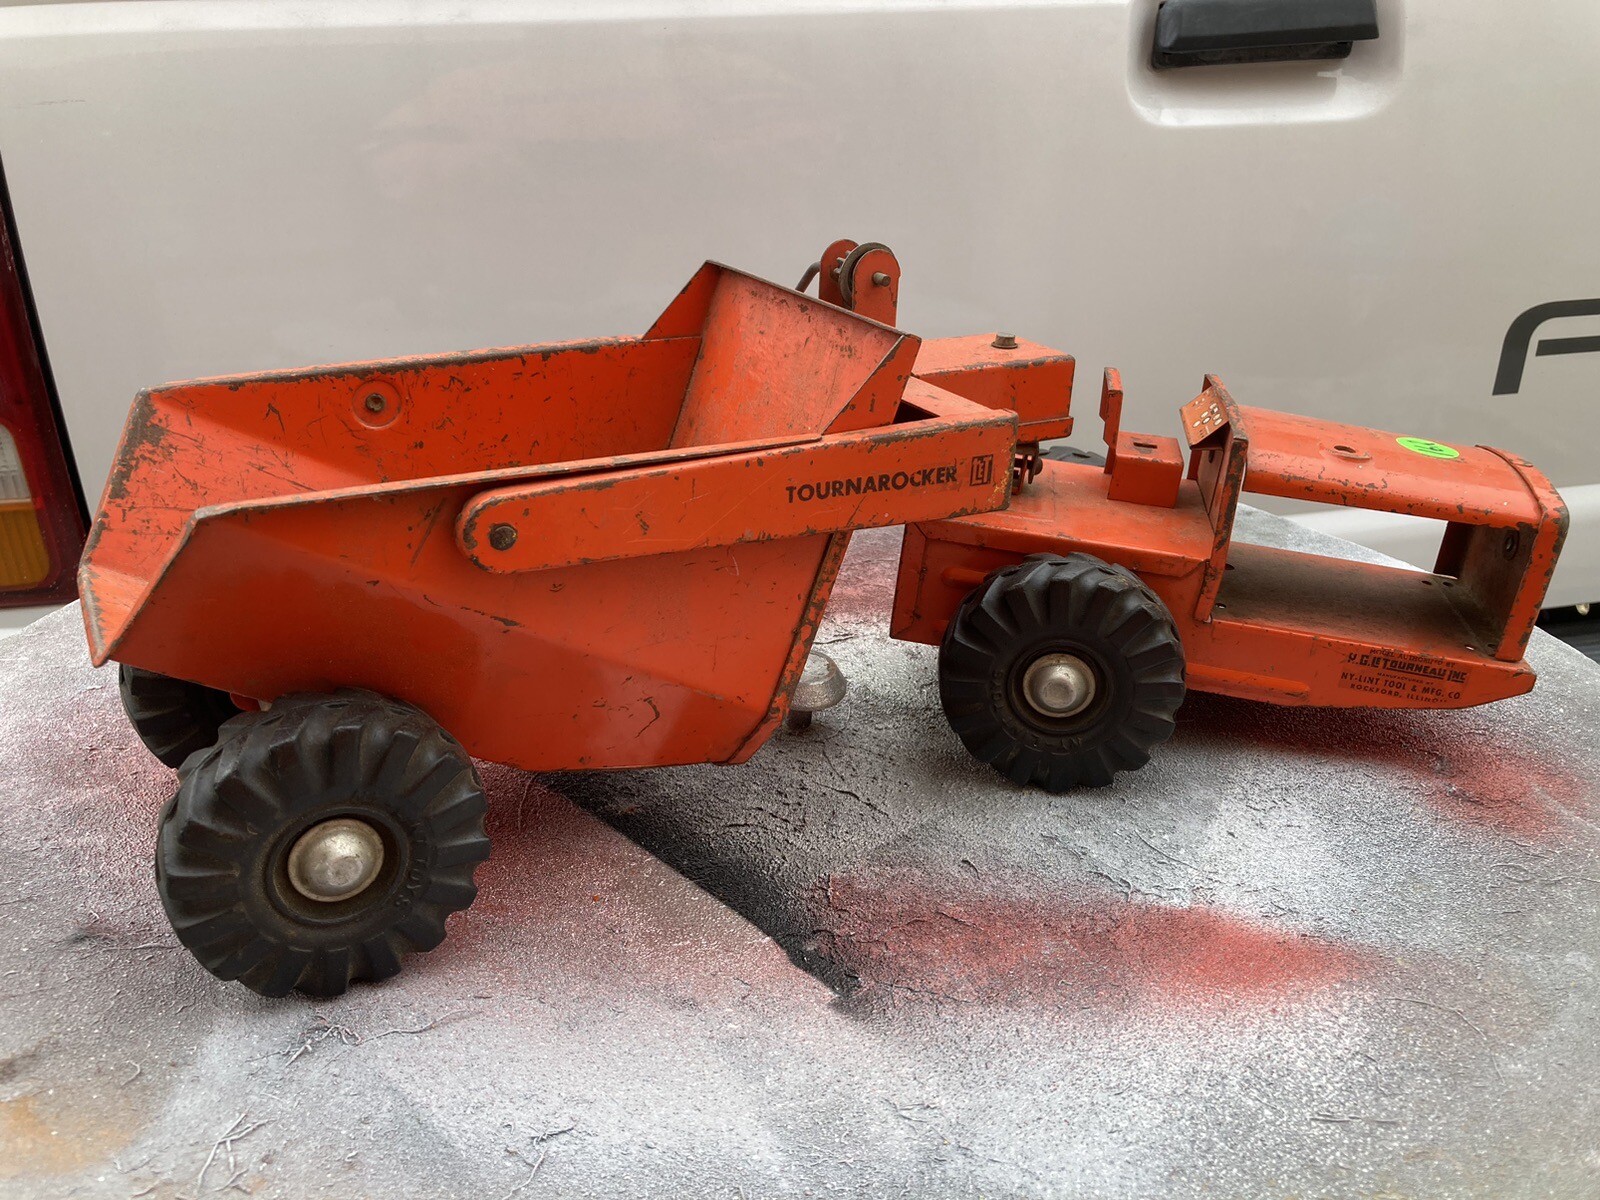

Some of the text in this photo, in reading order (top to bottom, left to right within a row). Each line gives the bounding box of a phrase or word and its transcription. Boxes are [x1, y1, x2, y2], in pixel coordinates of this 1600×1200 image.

[786, 466, 957, 503] TOURNAROCKER
[1341, 672, 1379, 686] NY-LINT
[1384, 678, 1406, 690] TOOL
[1421, 687, 1445, 698] MFG.
[1447, 670, 1467, 683] INC
